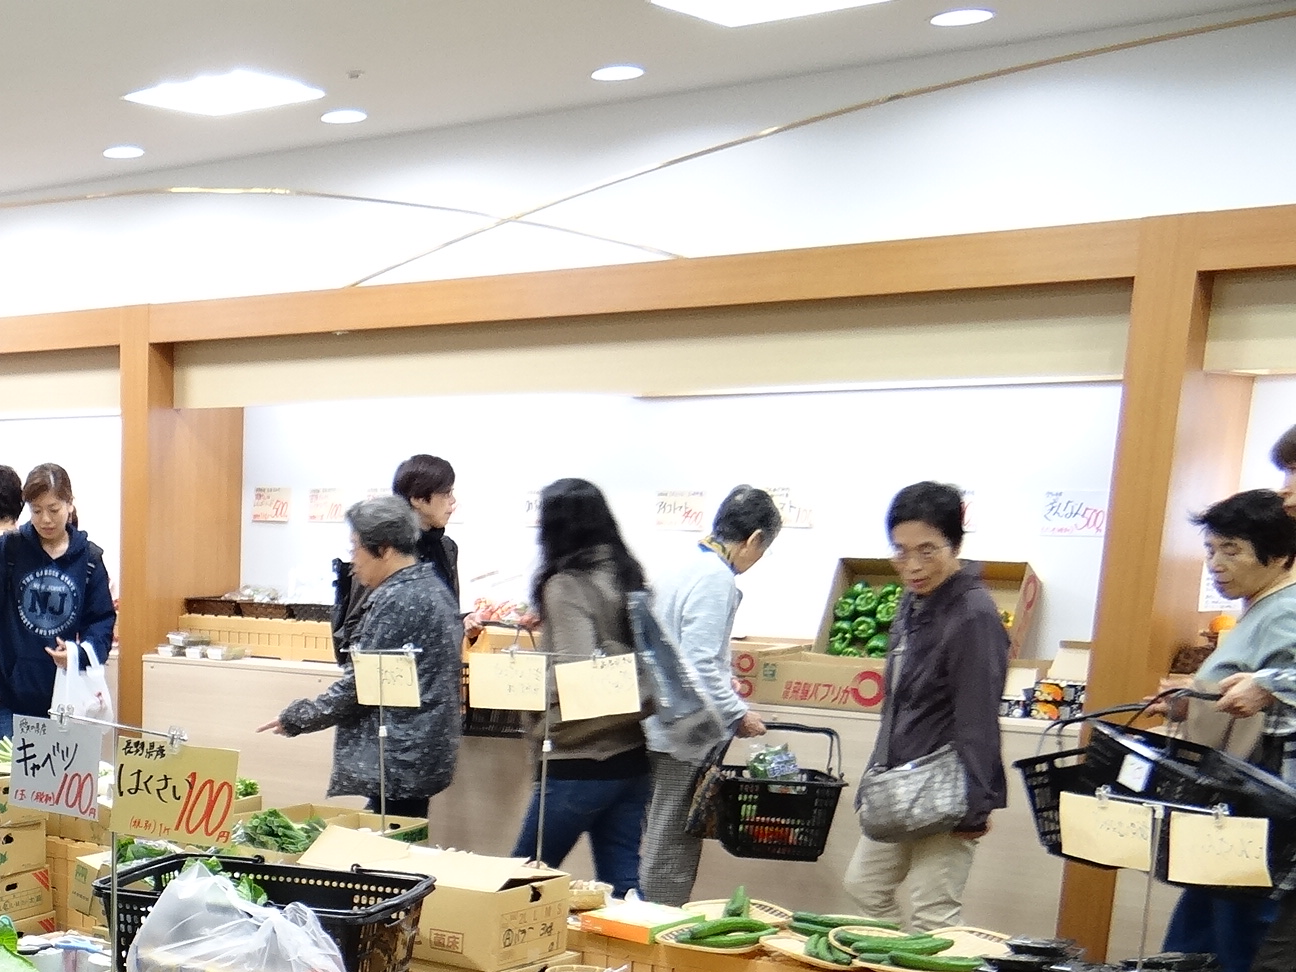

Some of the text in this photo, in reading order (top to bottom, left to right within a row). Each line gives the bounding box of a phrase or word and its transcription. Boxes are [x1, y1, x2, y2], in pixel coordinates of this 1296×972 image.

[28, 589, 68, 616] NJ
[16, 737, 79, 778] キャベツ
[122, 739, 167, 761] 長野県産
[117, 763, 195, 803] はくさい
